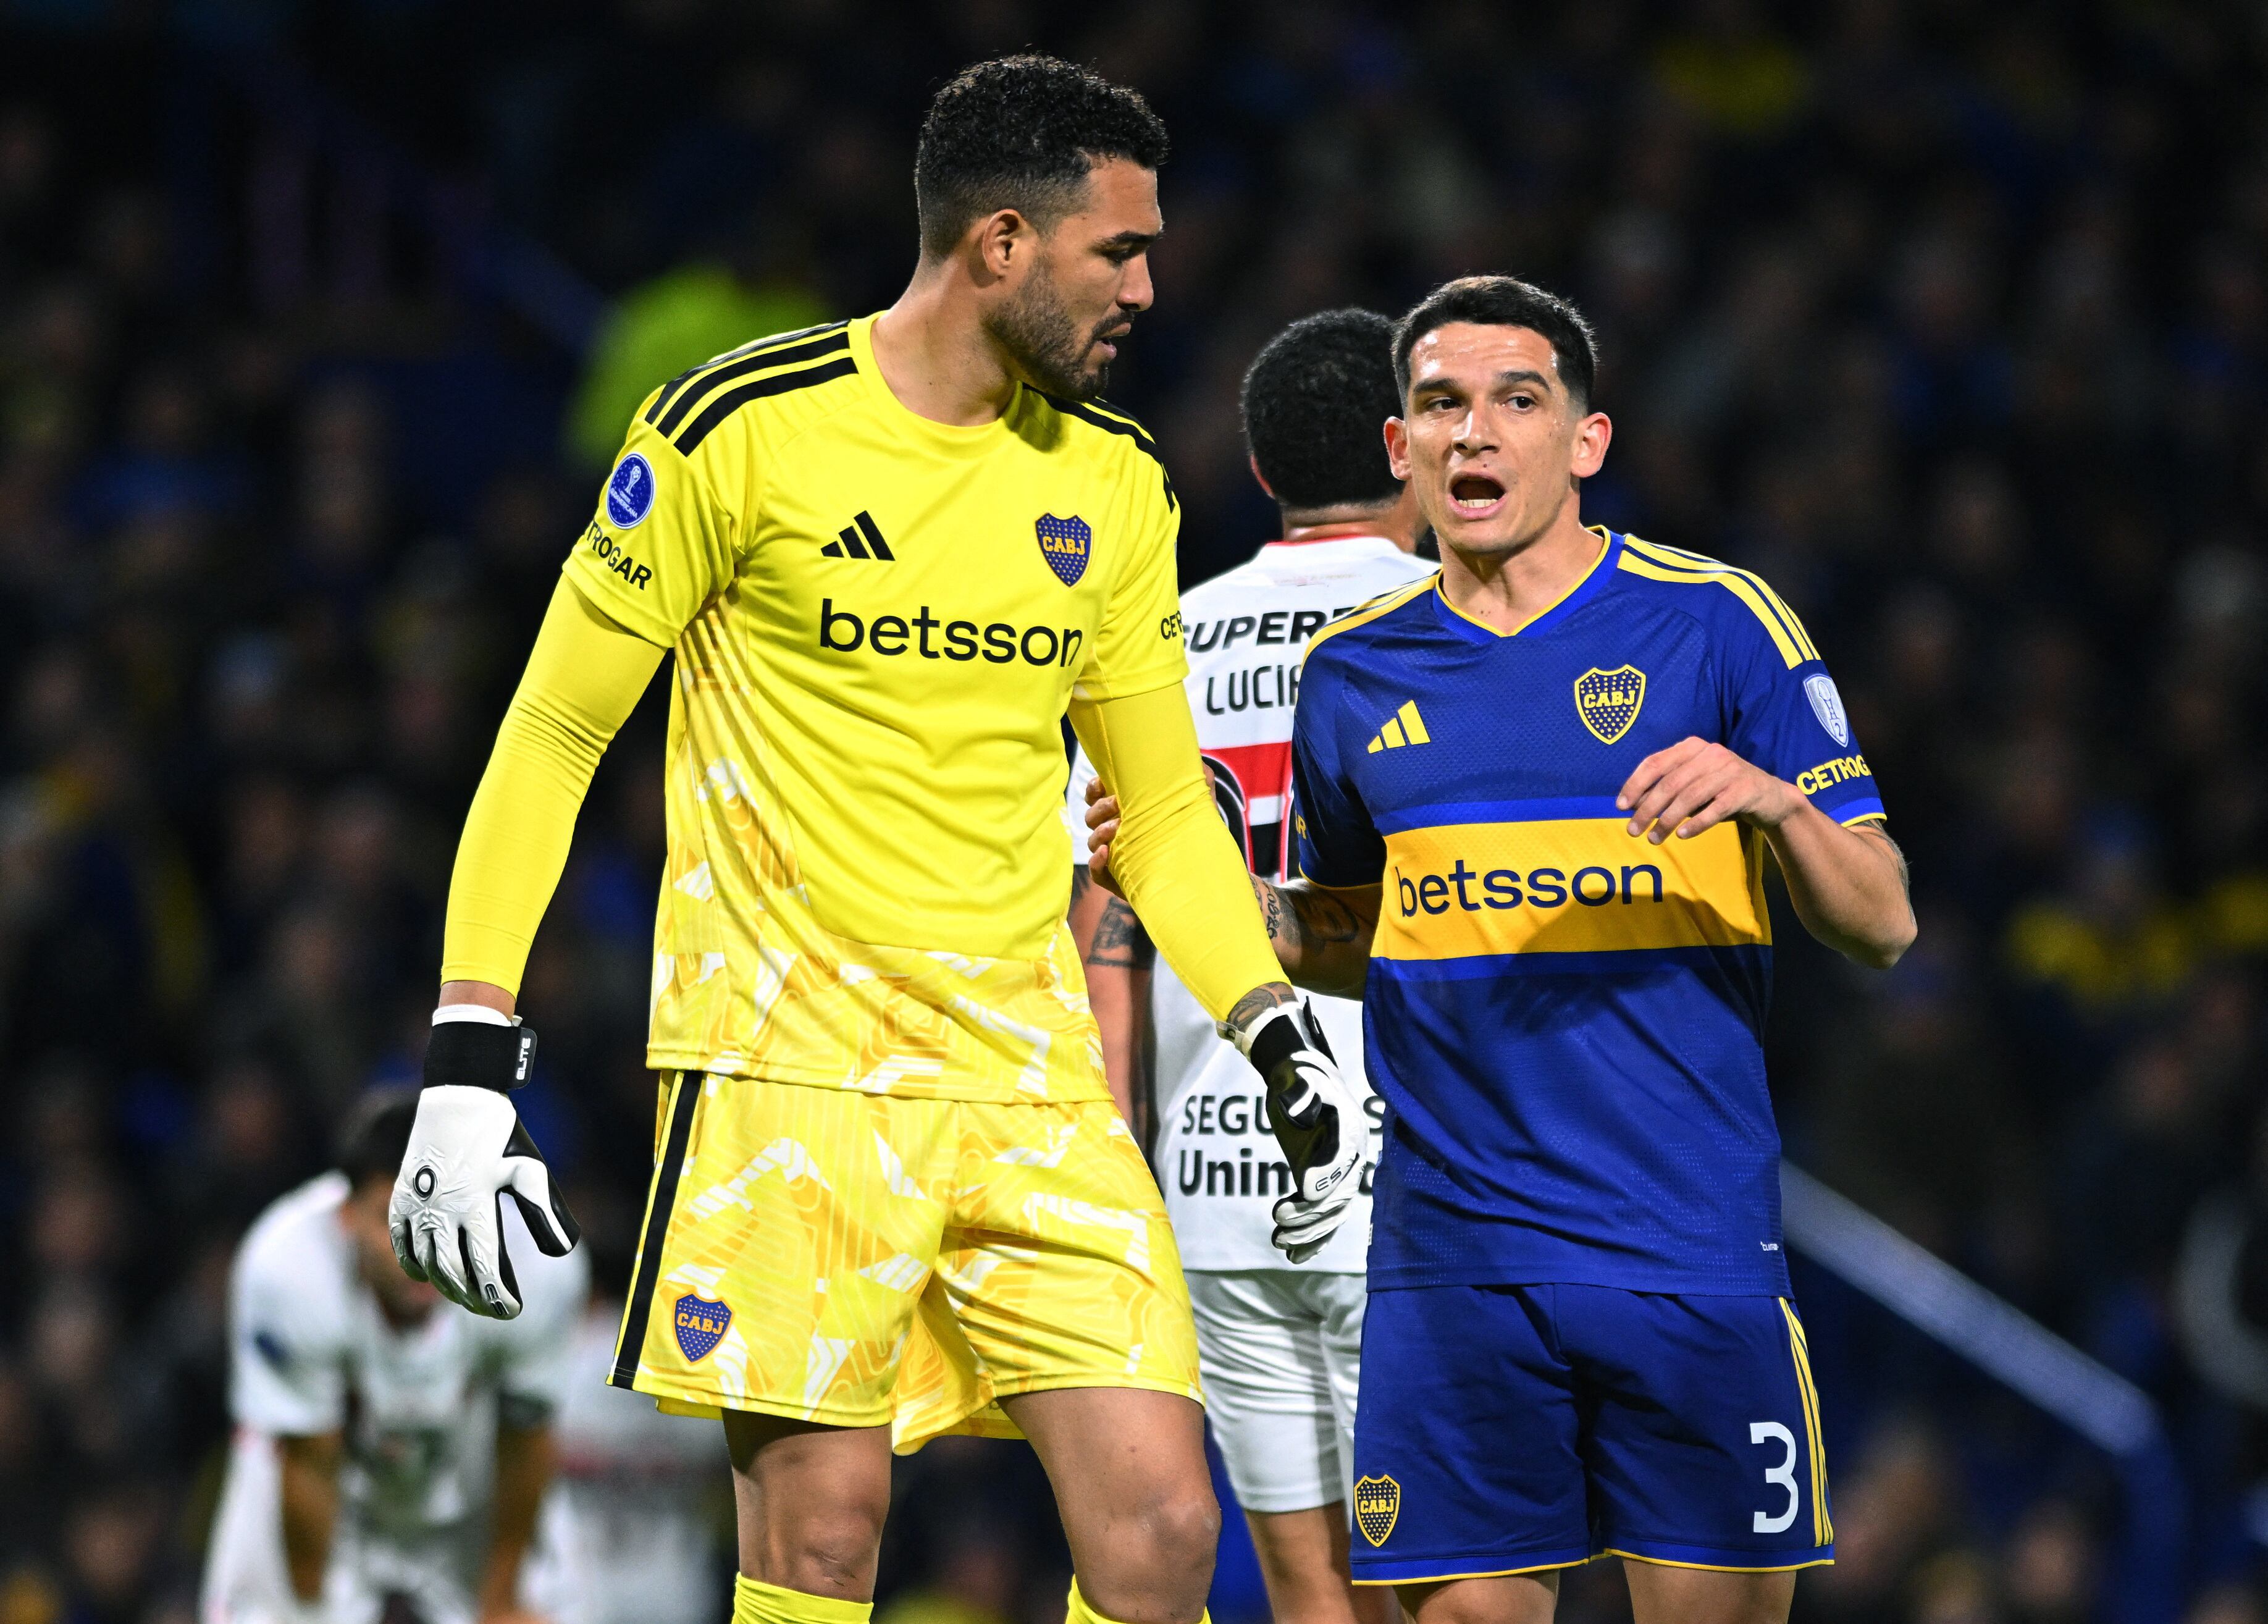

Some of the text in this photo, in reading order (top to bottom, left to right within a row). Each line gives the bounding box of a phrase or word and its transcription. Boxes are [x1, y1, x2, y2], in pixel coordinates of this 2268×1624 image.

[1042, 535, 1086, 555] CABJ
[819, 598, 1083, 668] betsson
[1183, 605, 1358, 654] UPER
[1584, 689, 1636, 709] CABJ
[1395, 859, 1664, 918] betsson
[516, 1037, 531, 1080] ELITE
[677, 1313, 724, 1335] CABJ
[1749, 1421, 1799, 1534] 3
[1360, 1499, 1394, 1514] CABJ
